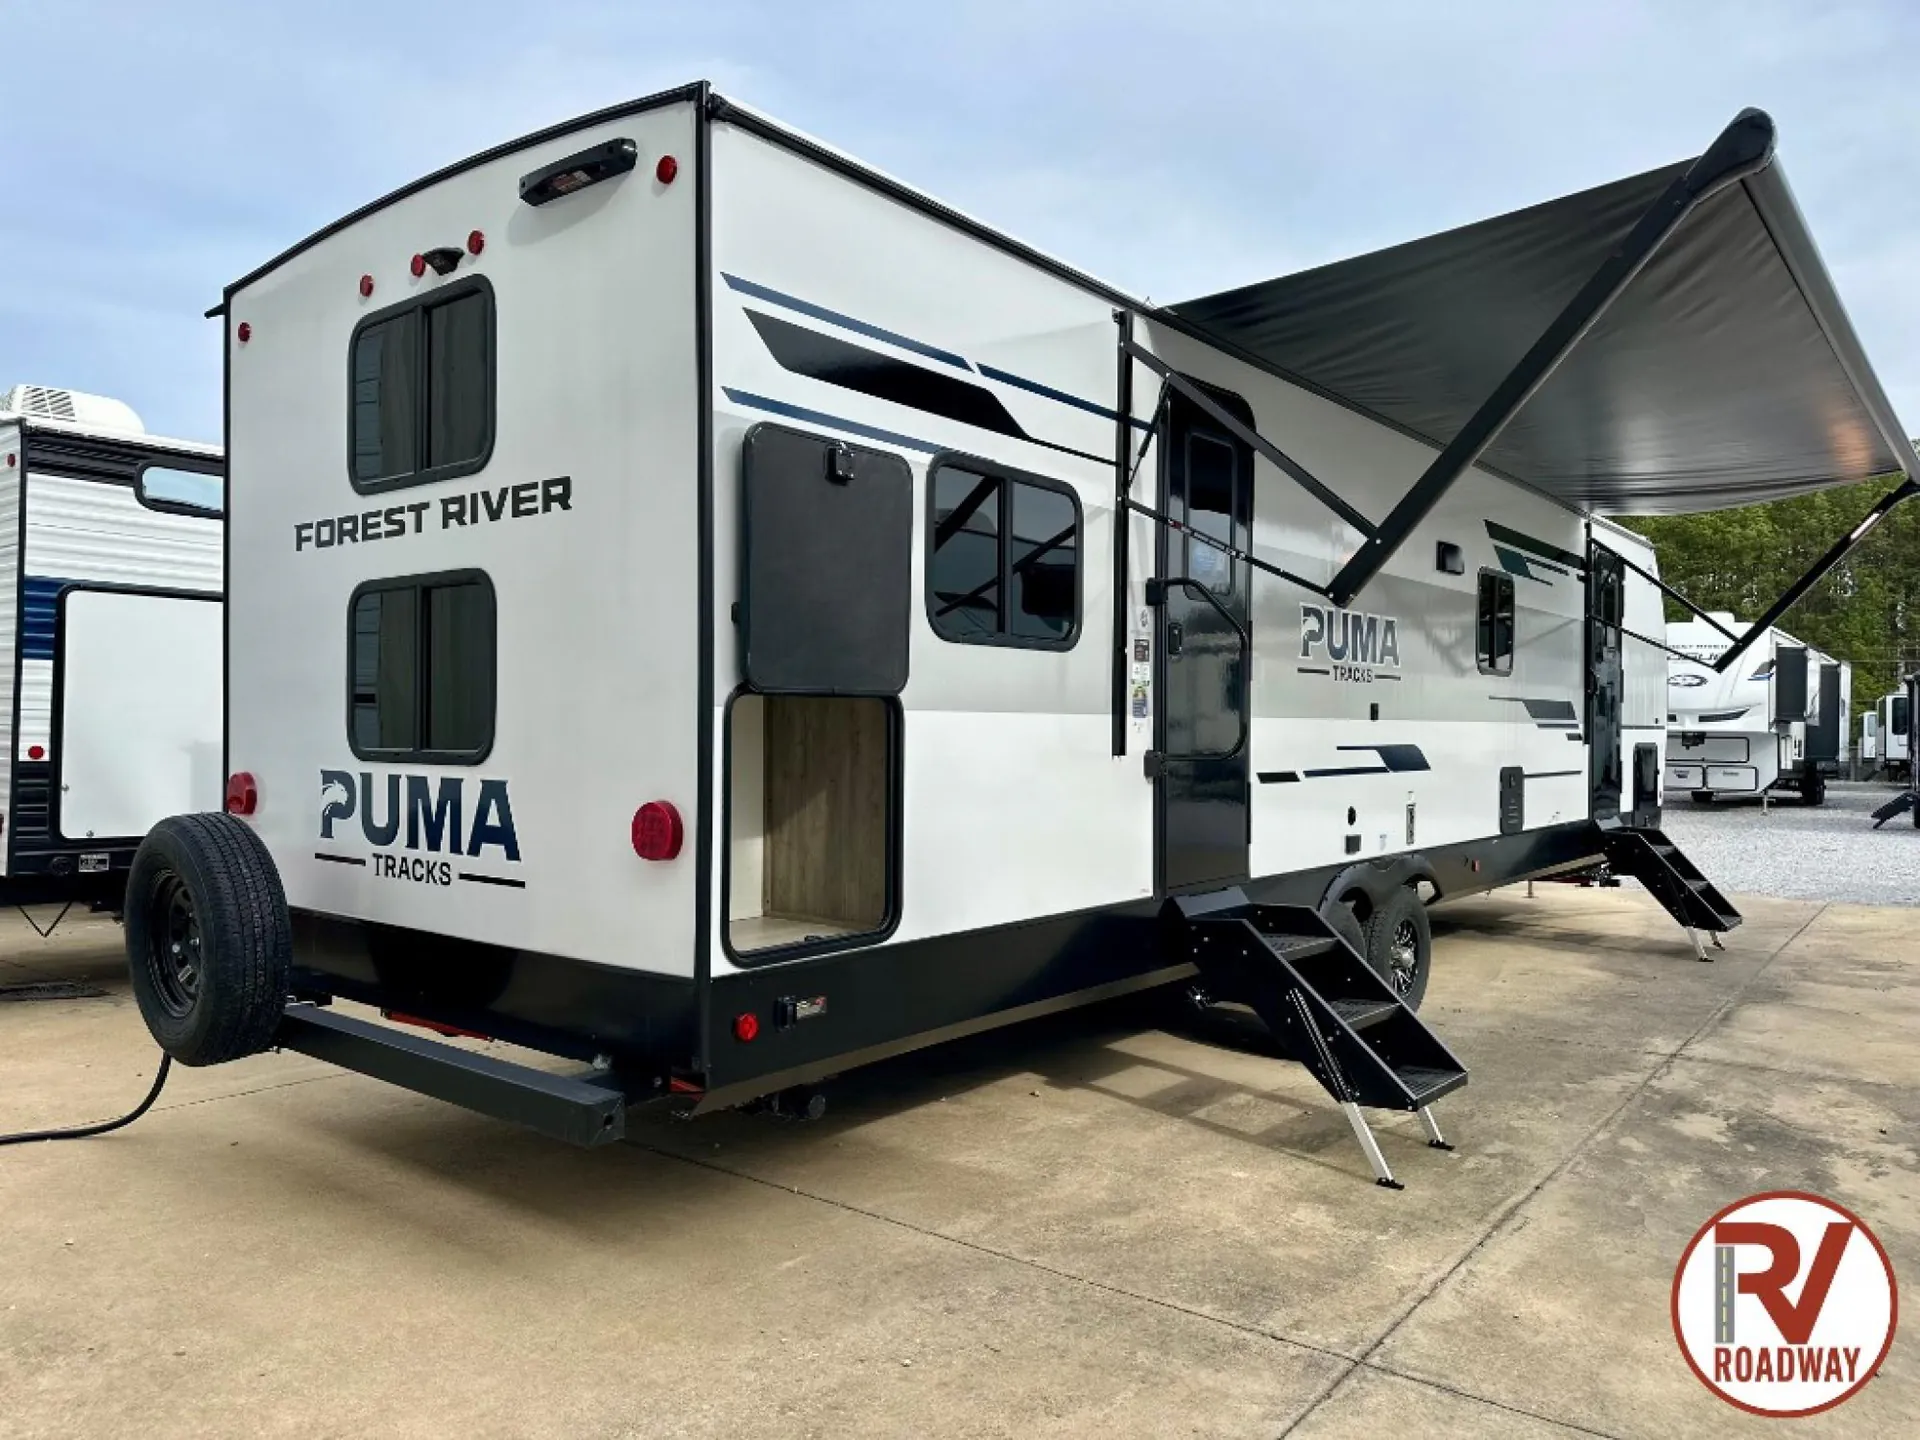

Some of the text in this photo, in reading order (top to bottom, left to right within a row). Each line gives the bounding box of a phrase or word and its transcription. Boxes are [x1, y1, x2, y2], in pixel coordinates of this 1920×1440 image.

[294, 476, 572, 551] FOREST RIVER
[1299, 603, 1399, 667] PUMA
[1333, 665, 1372, 683] TRACKS
[320, 769, 521, 862] PUMA
[372, 853, 451, 885] TRACKS
